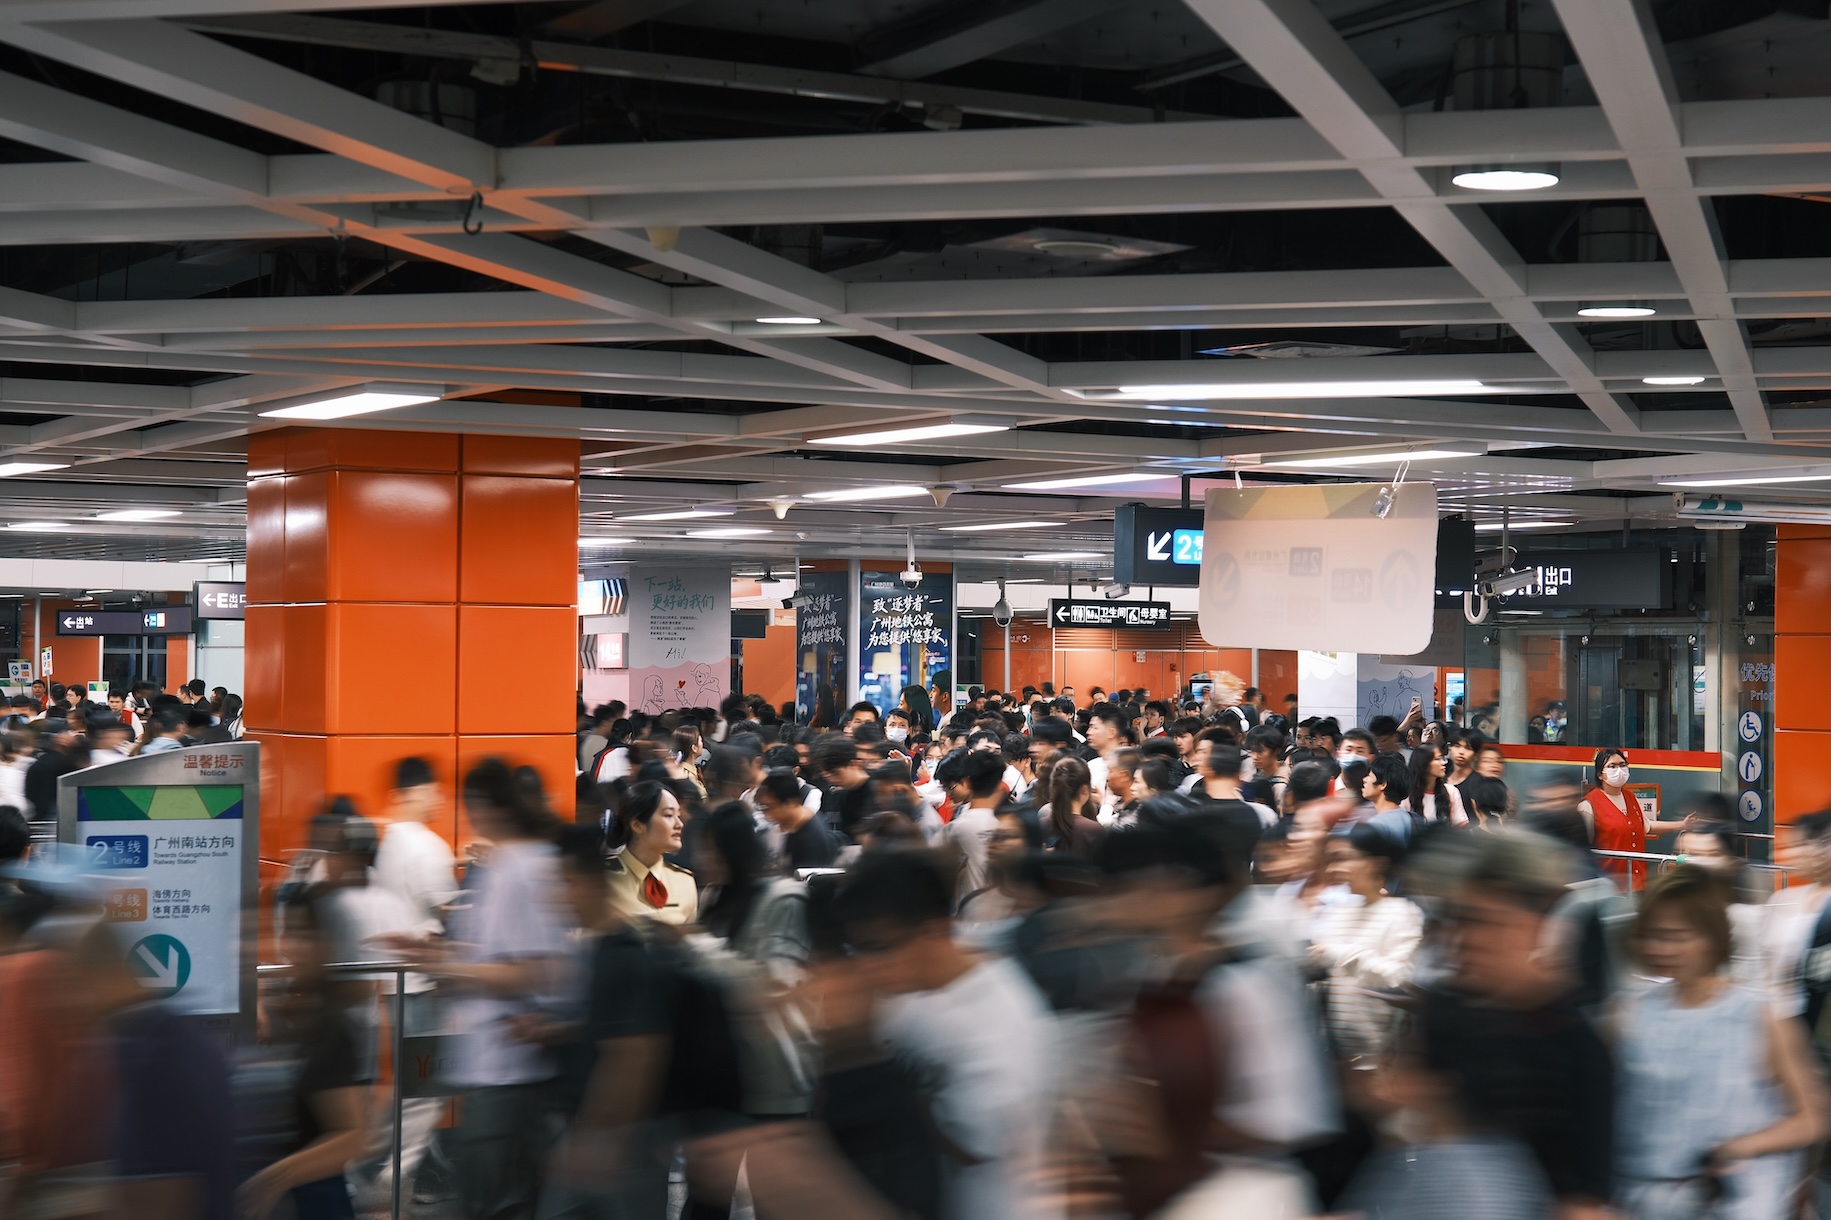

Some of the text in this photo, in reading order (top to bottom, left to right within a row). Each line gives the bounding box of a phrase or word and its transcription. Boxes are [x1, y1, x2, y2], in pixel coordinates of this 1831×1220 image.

[650, 594, 715, 613] 更好的我们
[1100, 606, 1168, 620] 卫生间 母婴室
[869, 612, 934, 632] 广州地铁公寓
[666, 647, 687, 660] Hi!
[183, 754, 245, 769] 温馨提示
[200, 769, 227, 777] Notice
[153, 836, 235, 850] 广州南站方向
[178, 851, 210, 859] Guangzhou
[152, 889, 191, 899] 海傍方向
[152, 904, 210, 915] 体育西路方向
